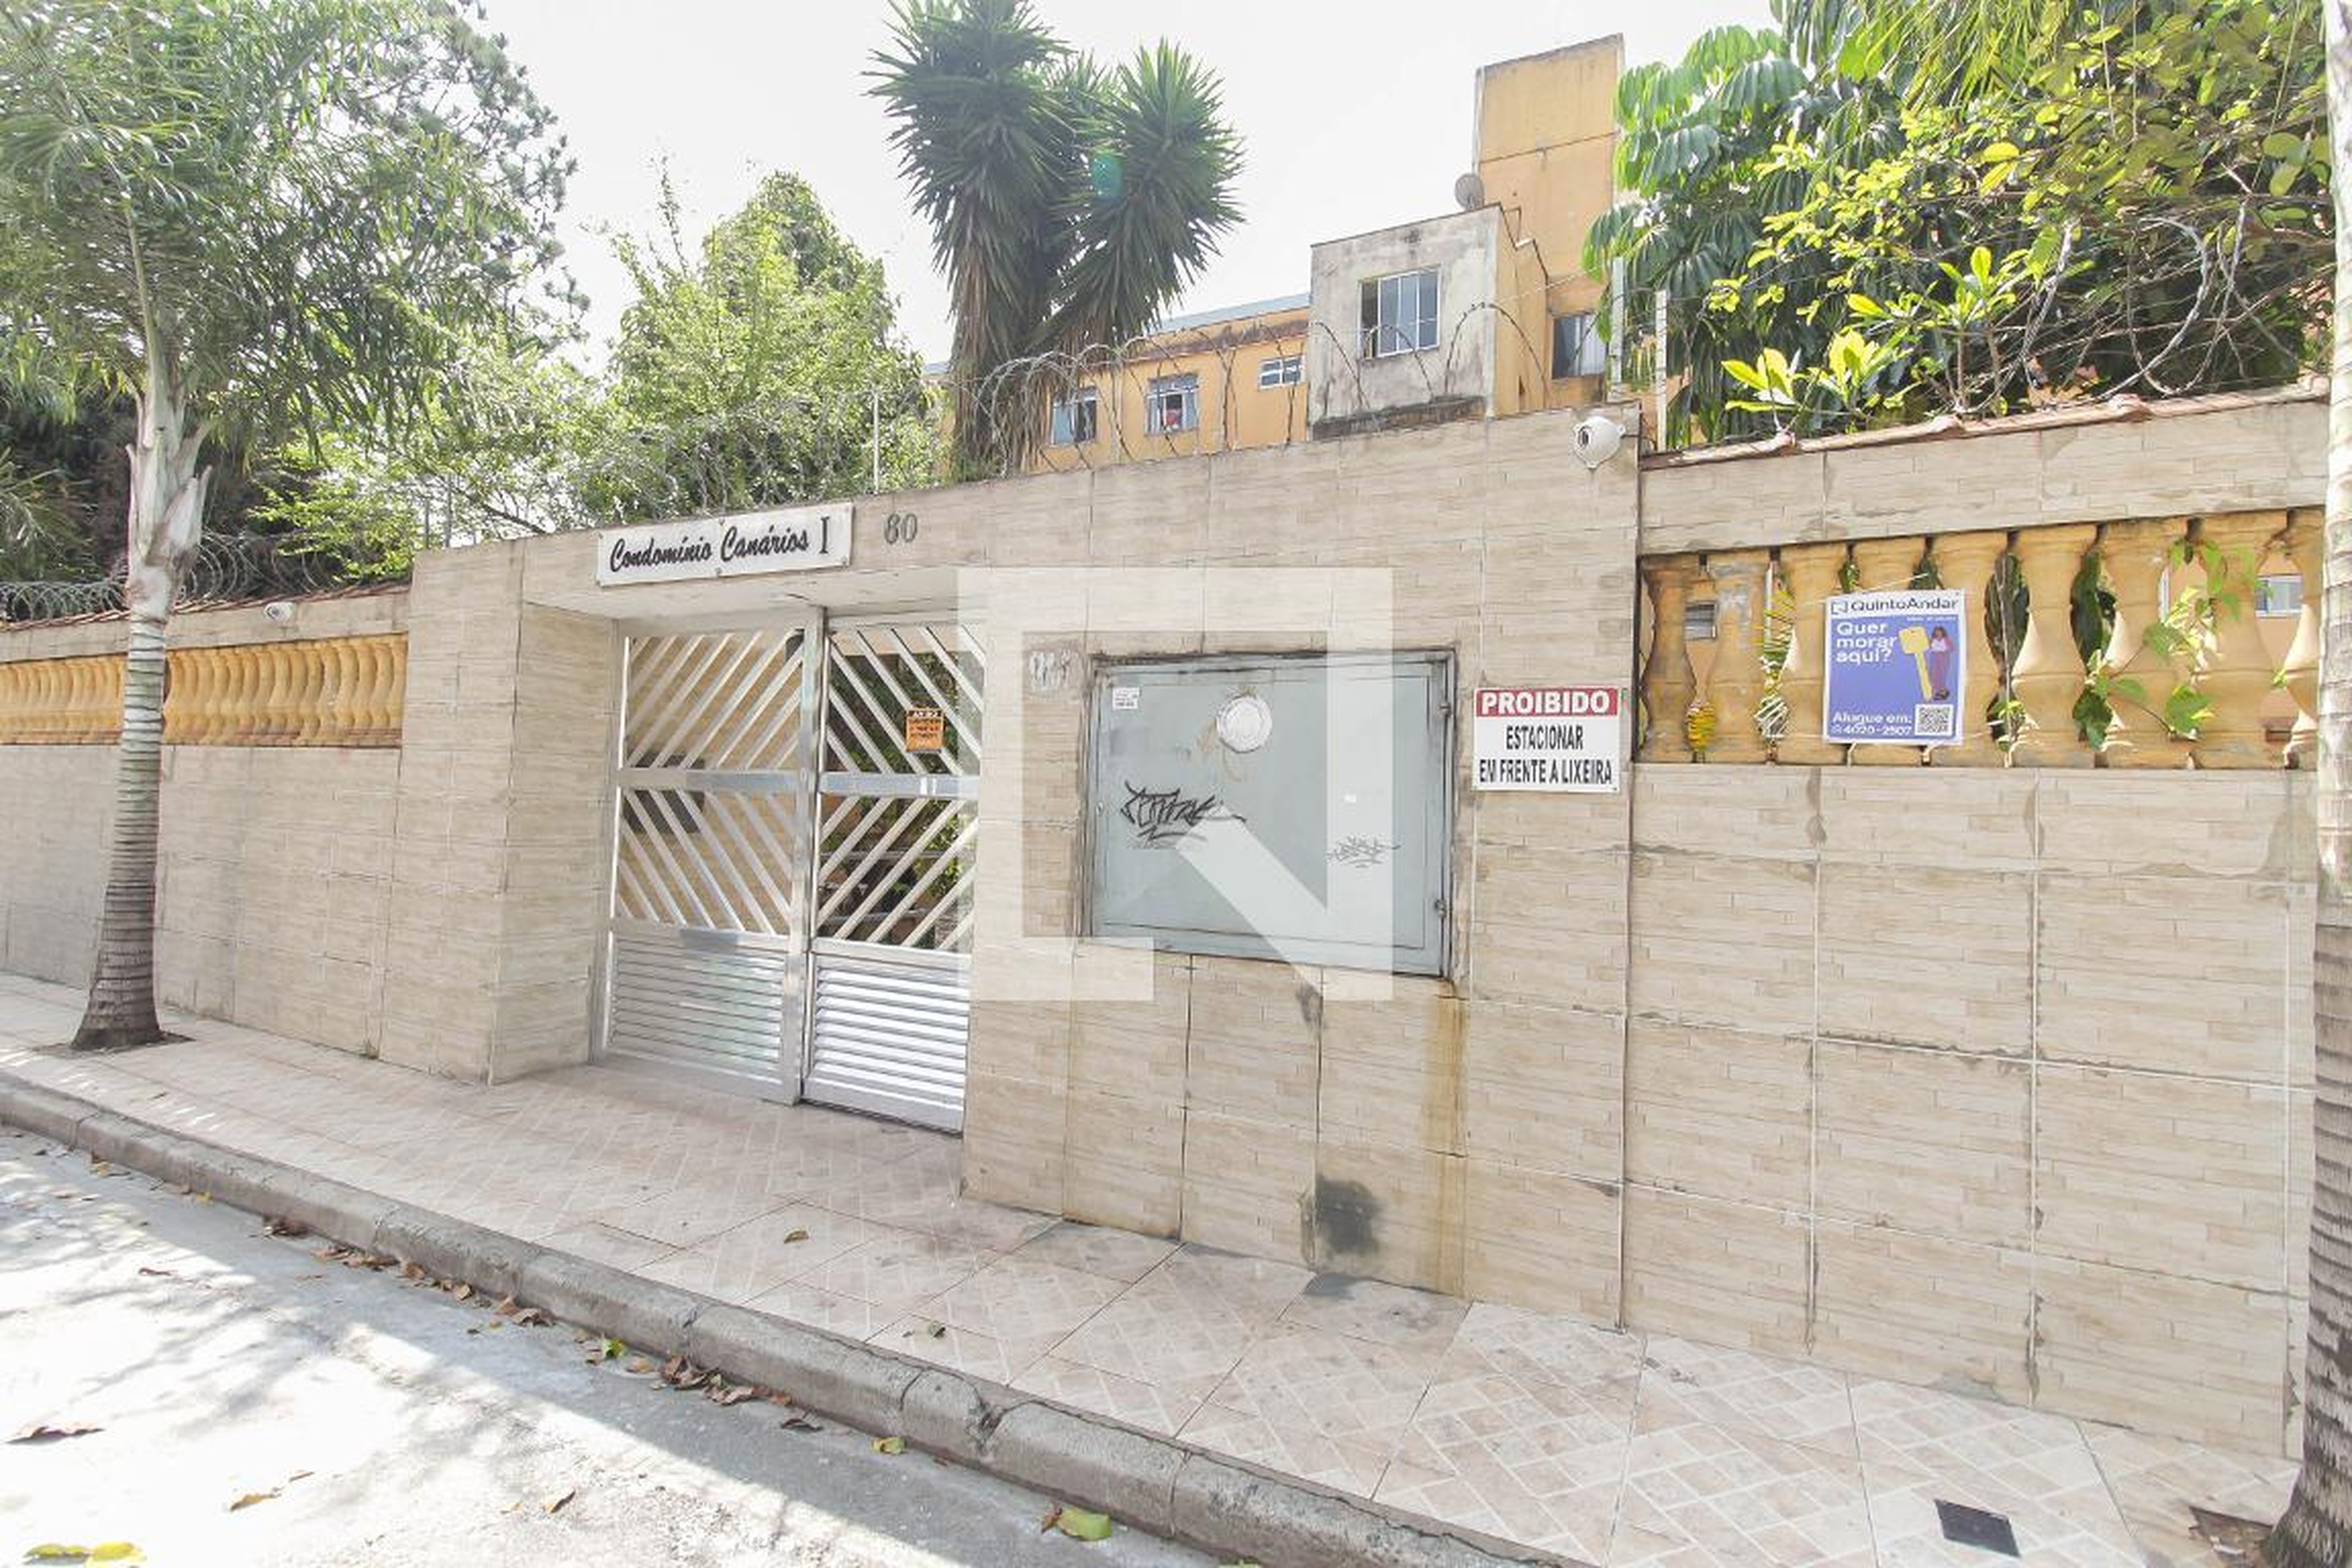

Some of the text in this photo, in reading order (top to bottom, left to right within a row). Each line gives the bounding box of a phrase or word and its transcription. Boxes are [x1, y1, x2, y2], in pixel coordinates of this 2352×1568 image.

[610, 516, 830, 572] Condomínio Canários I
[1851, 598, 1958, 611] QuintoAndar
[1837, 622, 1887, 635] Quer
[1837, 637, 1896, 649] morar
[1836, 649, 1891, 665] aqui?
[1481, 690, 1610, 714] PROIBIDO
[1832, 711, 1883, 724] Alugue
[1506, 725, 1583, 750] ESTACIONAR
[1480, 759, 1612, 784] EM FRENTE A LIXEIRA
